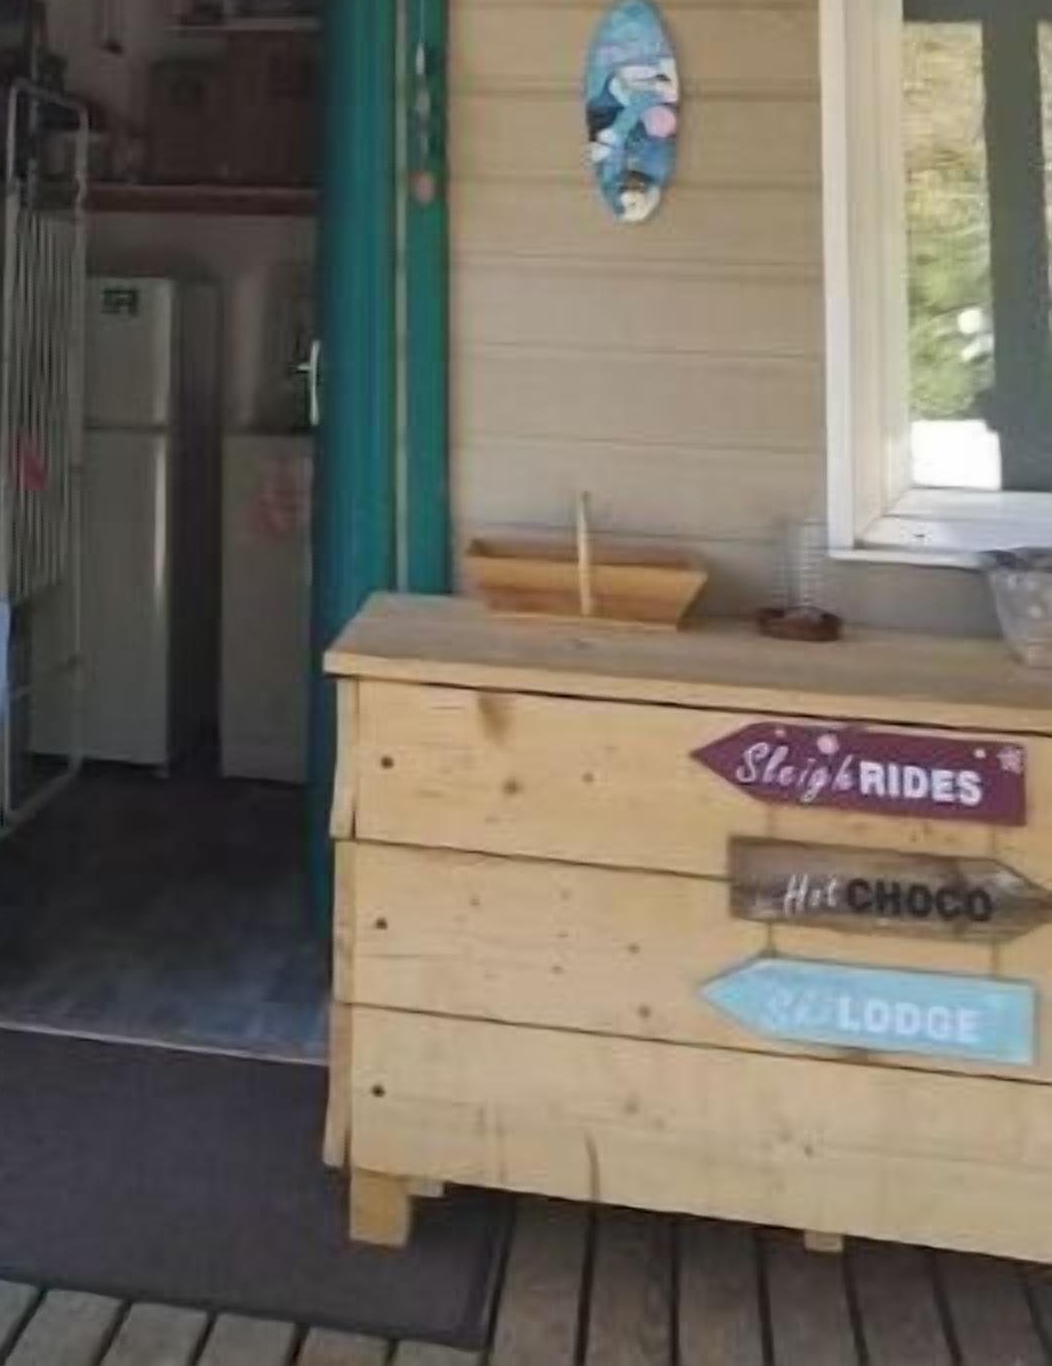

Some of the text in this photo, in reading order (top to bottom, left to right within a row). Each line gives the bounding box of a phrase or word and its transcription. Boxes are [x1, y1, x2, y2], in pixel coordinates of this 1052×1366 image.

[736, 741, 984, 807] Sleigh RIDES
[782, 873, 993, 923] Hot CHOCO
[836, 995, 982, 1045] LODGE
